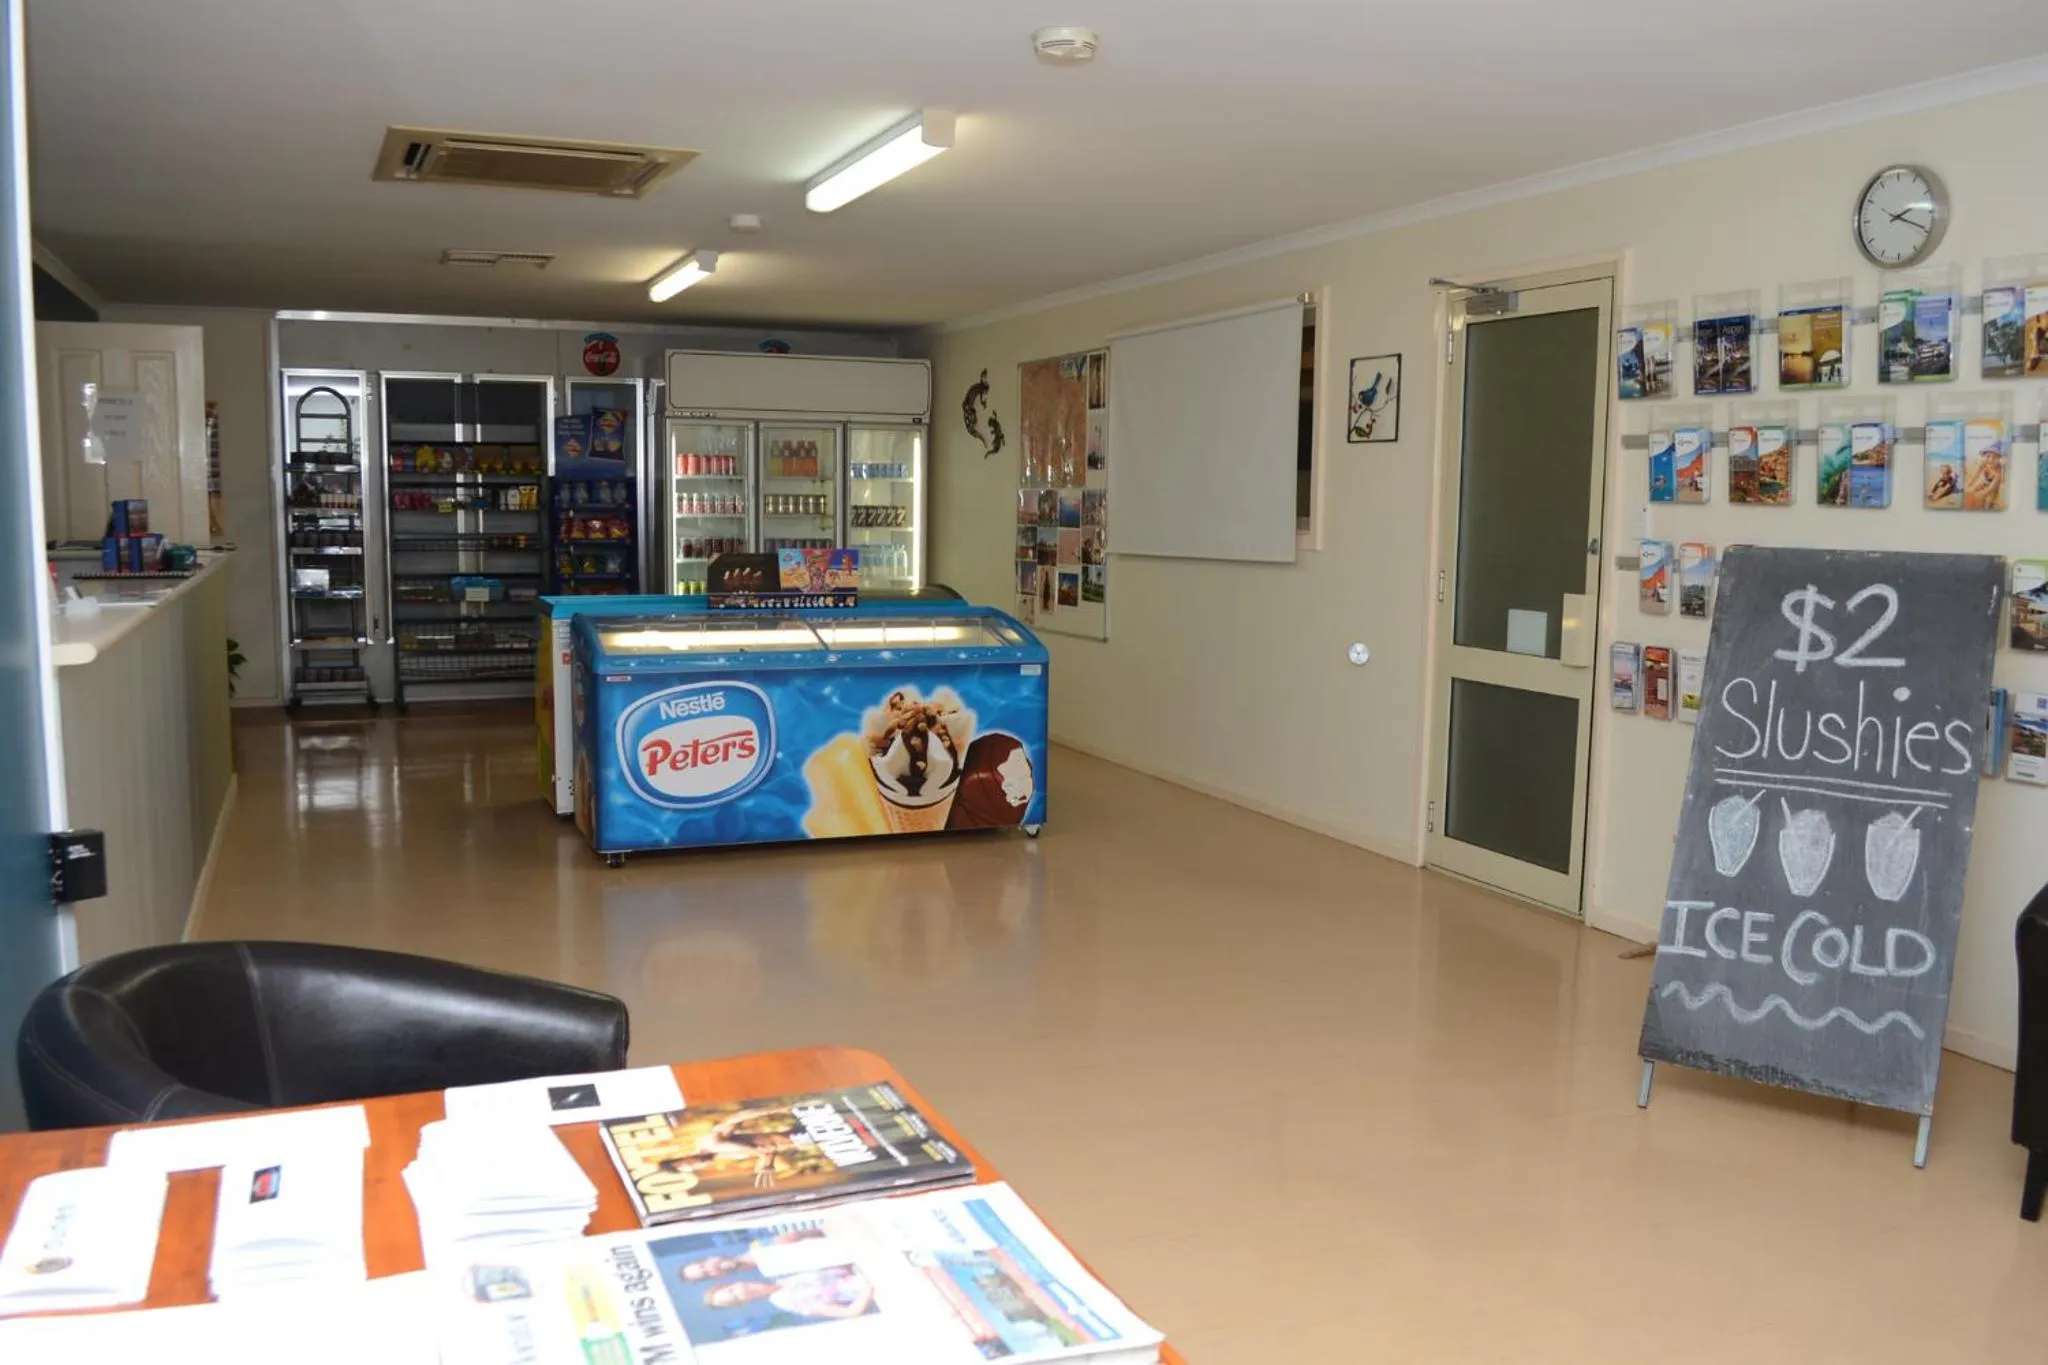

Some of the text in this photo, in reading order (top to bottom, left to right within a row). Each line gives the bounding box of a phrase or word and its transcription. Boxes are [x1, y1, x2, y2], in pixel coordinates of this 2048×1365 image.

[1773, 583, 1906, 673] $2
[660, 692, 726, 720] Nestlé
[1715, 677, 1973, 779] Slushies
[642, 730, 756, 776] Peters
[1656, 901, 1936, 985] ICE COLD
[604, 1244, 653, 1293] again
[628, 1297, 667, 1338] wins
